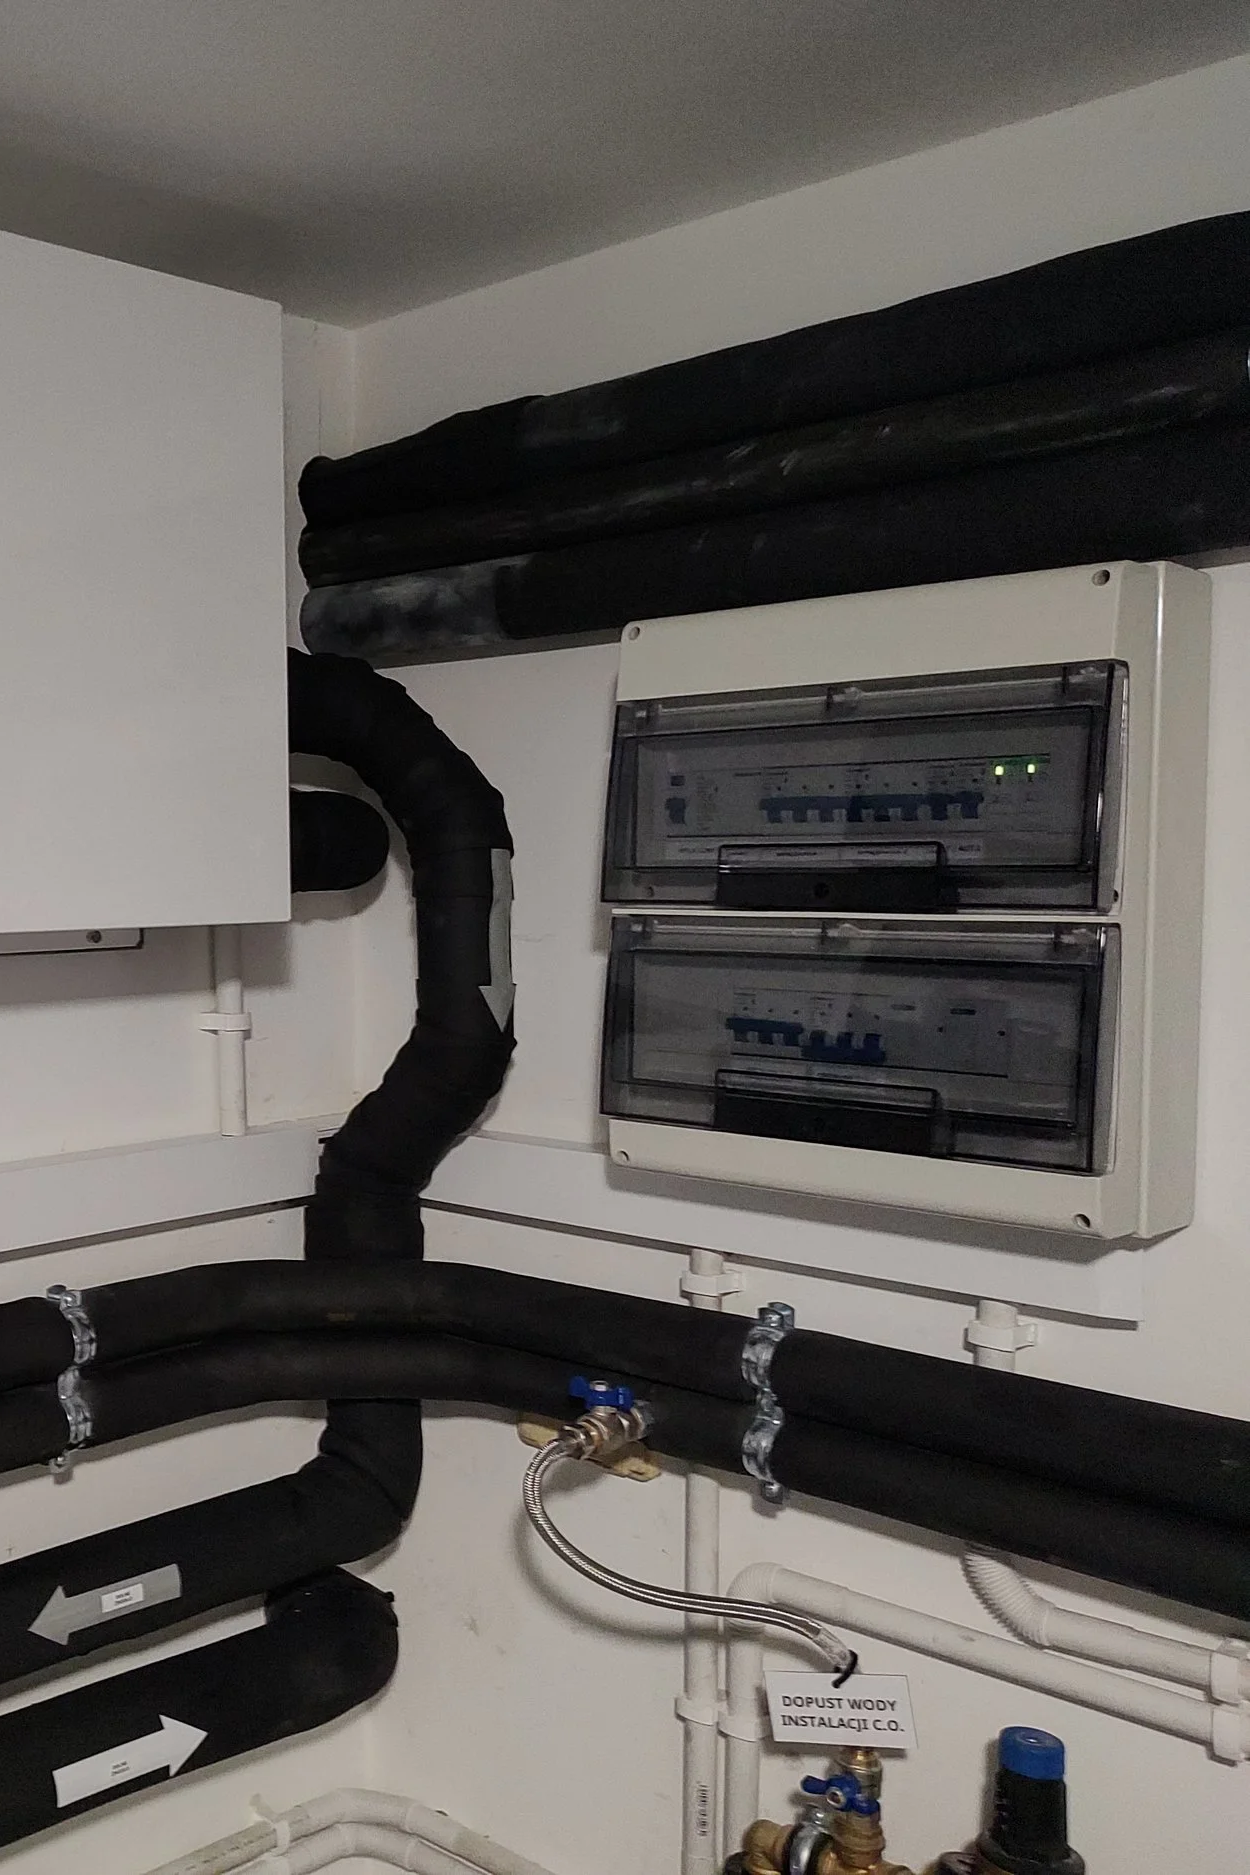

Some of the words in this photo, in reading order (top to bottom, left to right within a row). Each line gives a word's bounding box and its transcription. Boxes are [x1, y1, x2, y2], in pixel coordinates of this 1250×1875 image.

[781, 1695, 844, 1710] DOPUST
[847, 1698, 897, 1712] WODY
[781, 1714, 868, 1733] INSTALACJI
[872, 1719, 905, 1733] C.O.
